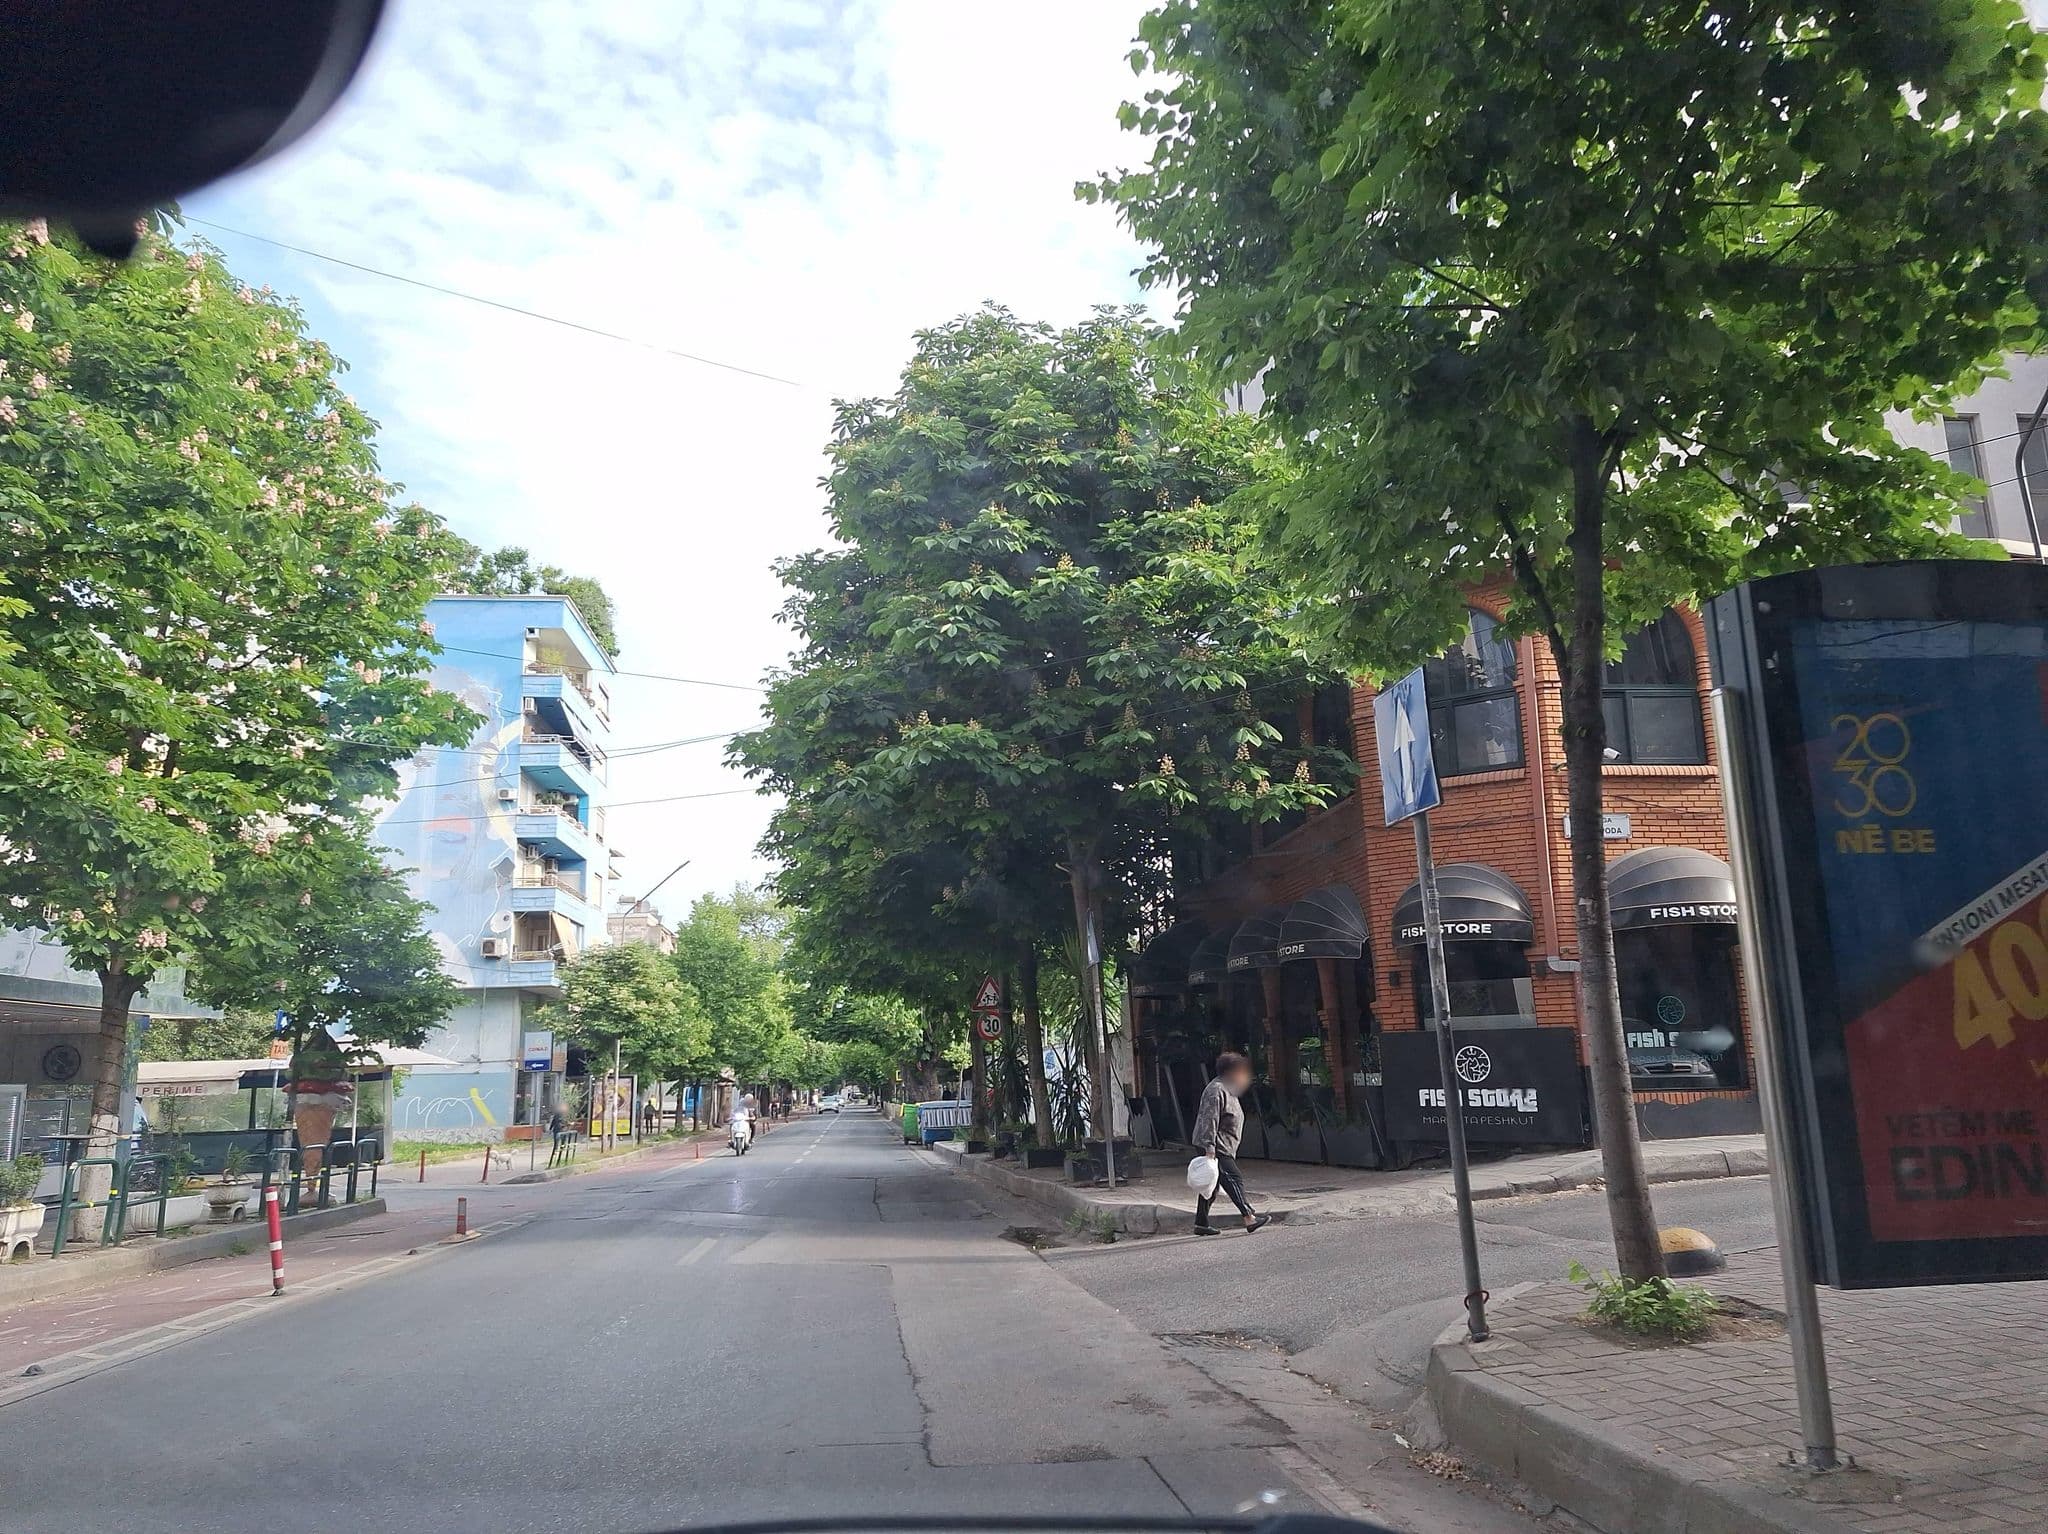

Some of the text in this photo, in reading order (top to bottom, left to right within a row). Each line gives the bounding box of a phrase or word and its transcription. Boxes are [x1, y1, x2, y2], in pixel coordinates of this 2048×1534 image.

[1832, 711, 1910, 764] 20
[1833, 764, 1916, 818] 30
[1889, 828, 1936, 854] BE
[1650, 906, 1695, 919] FISH
[1953, 894, 2048, 1051] 40
[984, 1019, 999, 1032] 30
